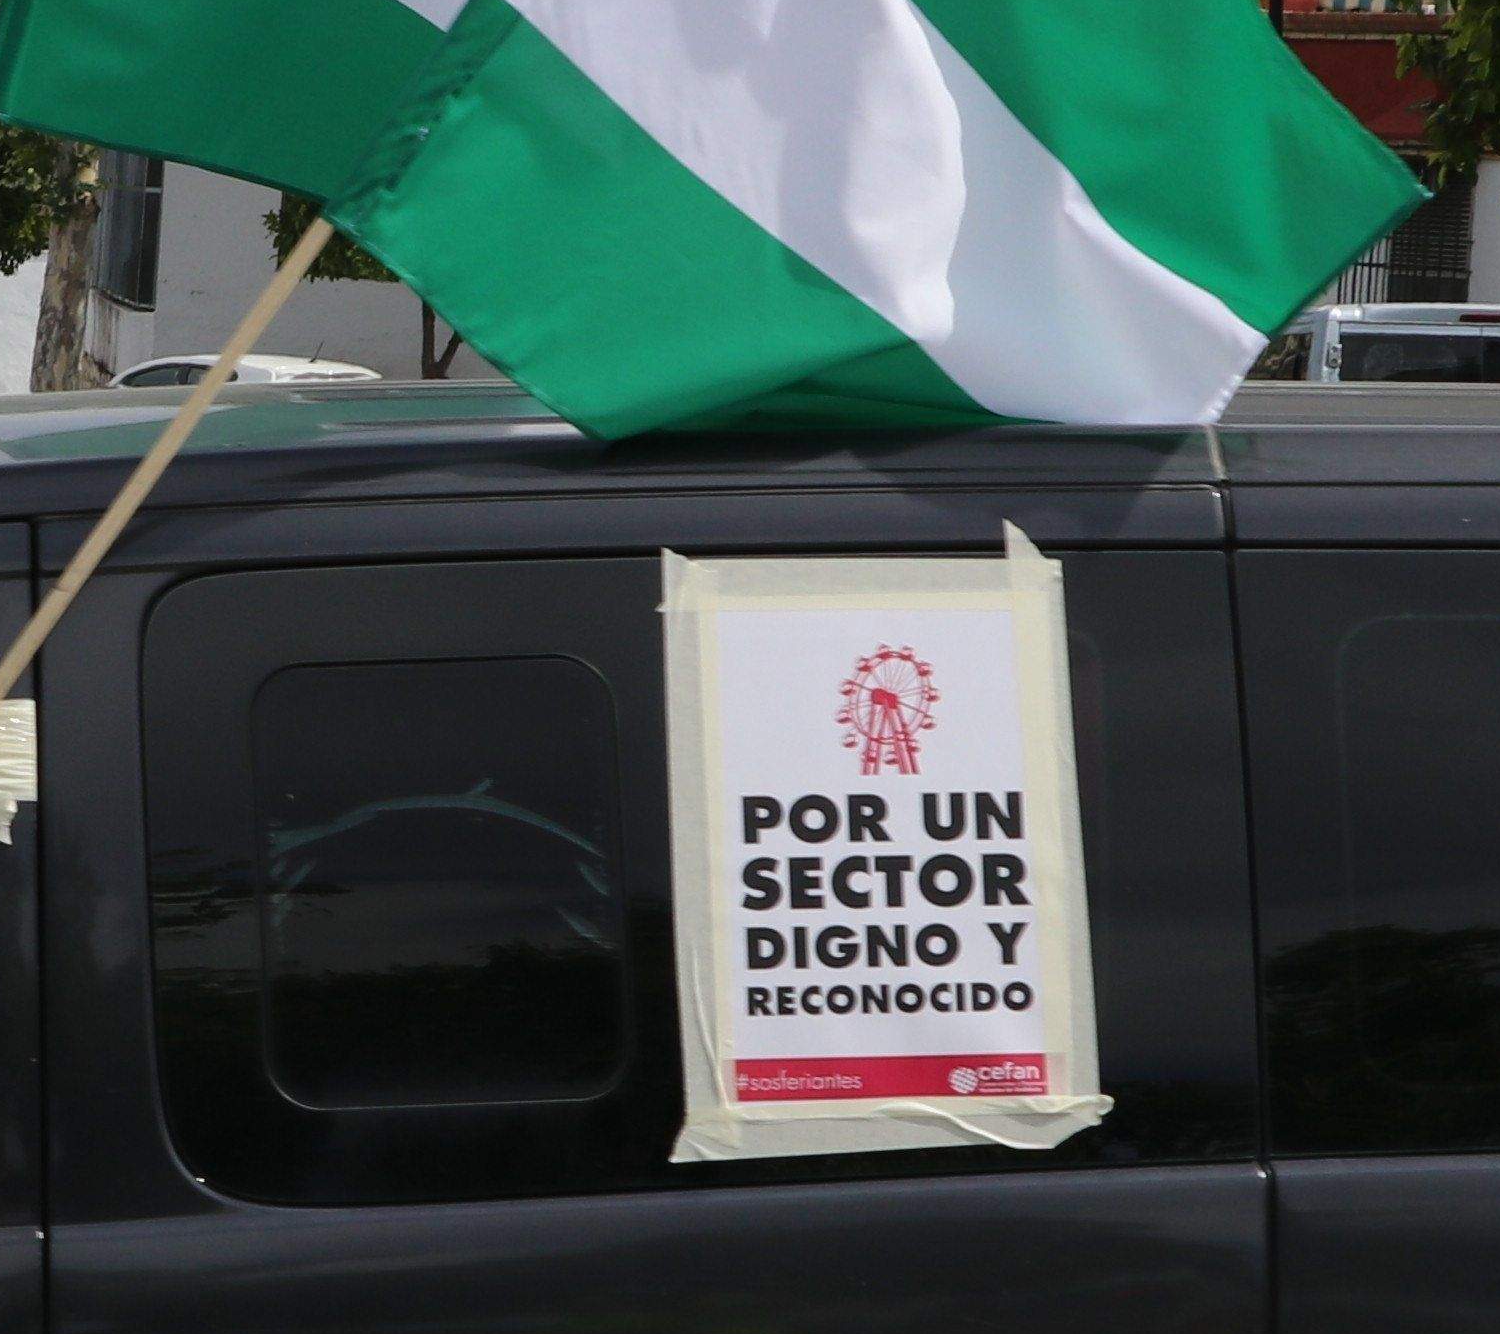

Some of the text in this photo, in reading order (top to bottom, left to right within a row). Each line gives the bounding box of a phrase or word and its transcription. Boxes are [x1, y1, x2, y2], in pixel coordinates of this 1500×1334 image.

[743, 791, 1023, 844] POR UN
[742, 853, 1030, 909] SECTOR
[747, 922, 1029, 969] DIGNO Y
[747, 981, 1034, 1016] RECONOCIDO
[737, 1069, 863, 1091] #sosferiantes
[977, 1062, 1040, 1081] cefan
